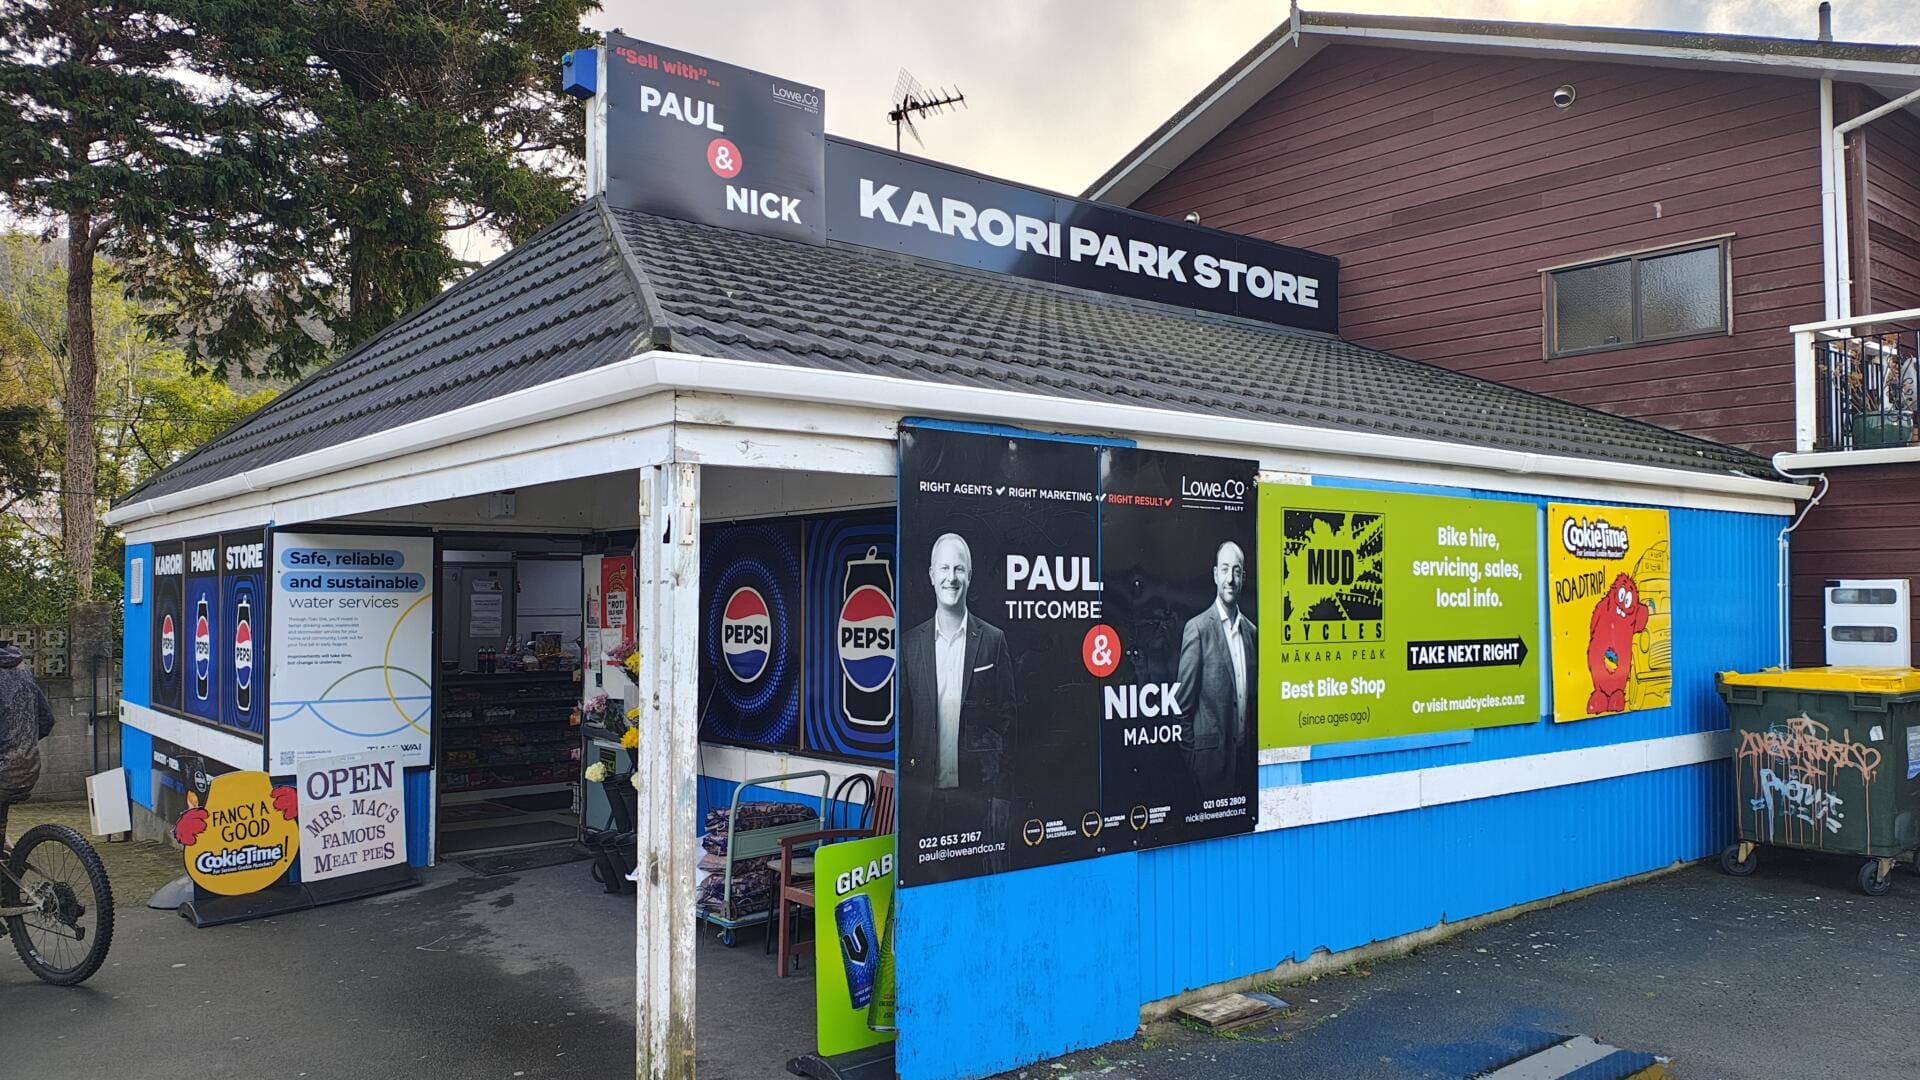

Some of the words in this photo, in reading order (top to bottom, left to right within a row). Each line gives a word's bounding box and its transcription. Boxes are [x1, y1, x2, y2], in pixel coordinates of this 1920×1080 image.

[640, 85, 724, 132] PAUL
[715, 146, 733, 171] &
[726, 185, 802, 224] NICK
[859, 178, 1061, 258] KARORI
[1070, 227, 1188, 283] PARK
[1193, 255, 1319, 309] STORE
[920, 481, 950, 492] RIGHT
[954, 483, 993, 495] AGENTS
[1008, 487, 1037, 498] RIGHT
[1039, 489, 1092, 501] MARKETING
[1108, 494, 1134, 504] RIGHT
[1135, 496, 1163, 506] RESULT
[1438, 527, 1467, 546] Bike
[1470, 528, 1500, 550] hire,
[155, 554, 183, 575] KARORI
[191, 549, 215, 572] PARK
[226, 543, 264, 570] STORE
[290, 552, 331, 567] Safe,
[335, 552, 395, 566] reliable
[1308, 549, 1354, 585] MUD
[1413, 556, 1482, 583] servicing,
[1485, 559, 1522, 580] sales,
[289, 576, 322, 588] and
[327, 576, 419, 589] sustainable
[1006, 555, 1104, 591] PAUL
[289, 597, 334, 608] water
[338, 595, 399, 608] services
[611, 600, 624, 608] ROTI
[1436, 588, 1470, 607] local
[1473, 587, 1503, 607] info.
[1005, 601, 1102, 619] TITCOMBE
[725, 625, 768, 645] PEPSI
[841, 627, 895, 650] PEPSI
[1284, 623, 1382, 641] CYCLES
[236, 647, 252, 662] PEPSI
[1091, 634, 1112, 666] &
[1410, 646, 1445, 665] TAKE
[1448, 644, 1481, 663] NEXT
[1483, 643, 1520, 661] RIGHT
[1281, 680, 1314, 699] Best
[1317, 677, 1348, 697] Bike
[1351, 676, 1386, 699] Shop
[1104, 682, 1182, 720] NICK
[1412, 701, 1425, 714] Or
[1427, 698, 1448, 712] visit
[1449, 694, 1525, 712] mudcycles.co.nz
[1298, 711, 1325, 728] (since
[1327, 711, 1348, 726] ages
[1350, 706, 1370, 724] ago)
[401, 743, 422, 751] WAI
[1123, 725, 1182, 746] MAJOR
[306, 760, 395, 800] OPEN
[212, 803, 254, 827] FANCY
[260, 801, 269, 816] A
[1203, 800, 1215, 809] 021
[1216, 798, 1229, 808] 055
[306, 804, 346, 838] MRS.
[352, 799, 400, 823] MAC'S
[221, 818, 270, 843] GOOD
[322, 824, 386, 849] FAMOUS
[919, 837, 938, 849] 022
[940, 834, 959, 846] 653
[960, 831, 982, 843] 2167
[919, 842, 1006, 864] paul@loweandco.nz
[836, 853, 893, 896] GRAB
